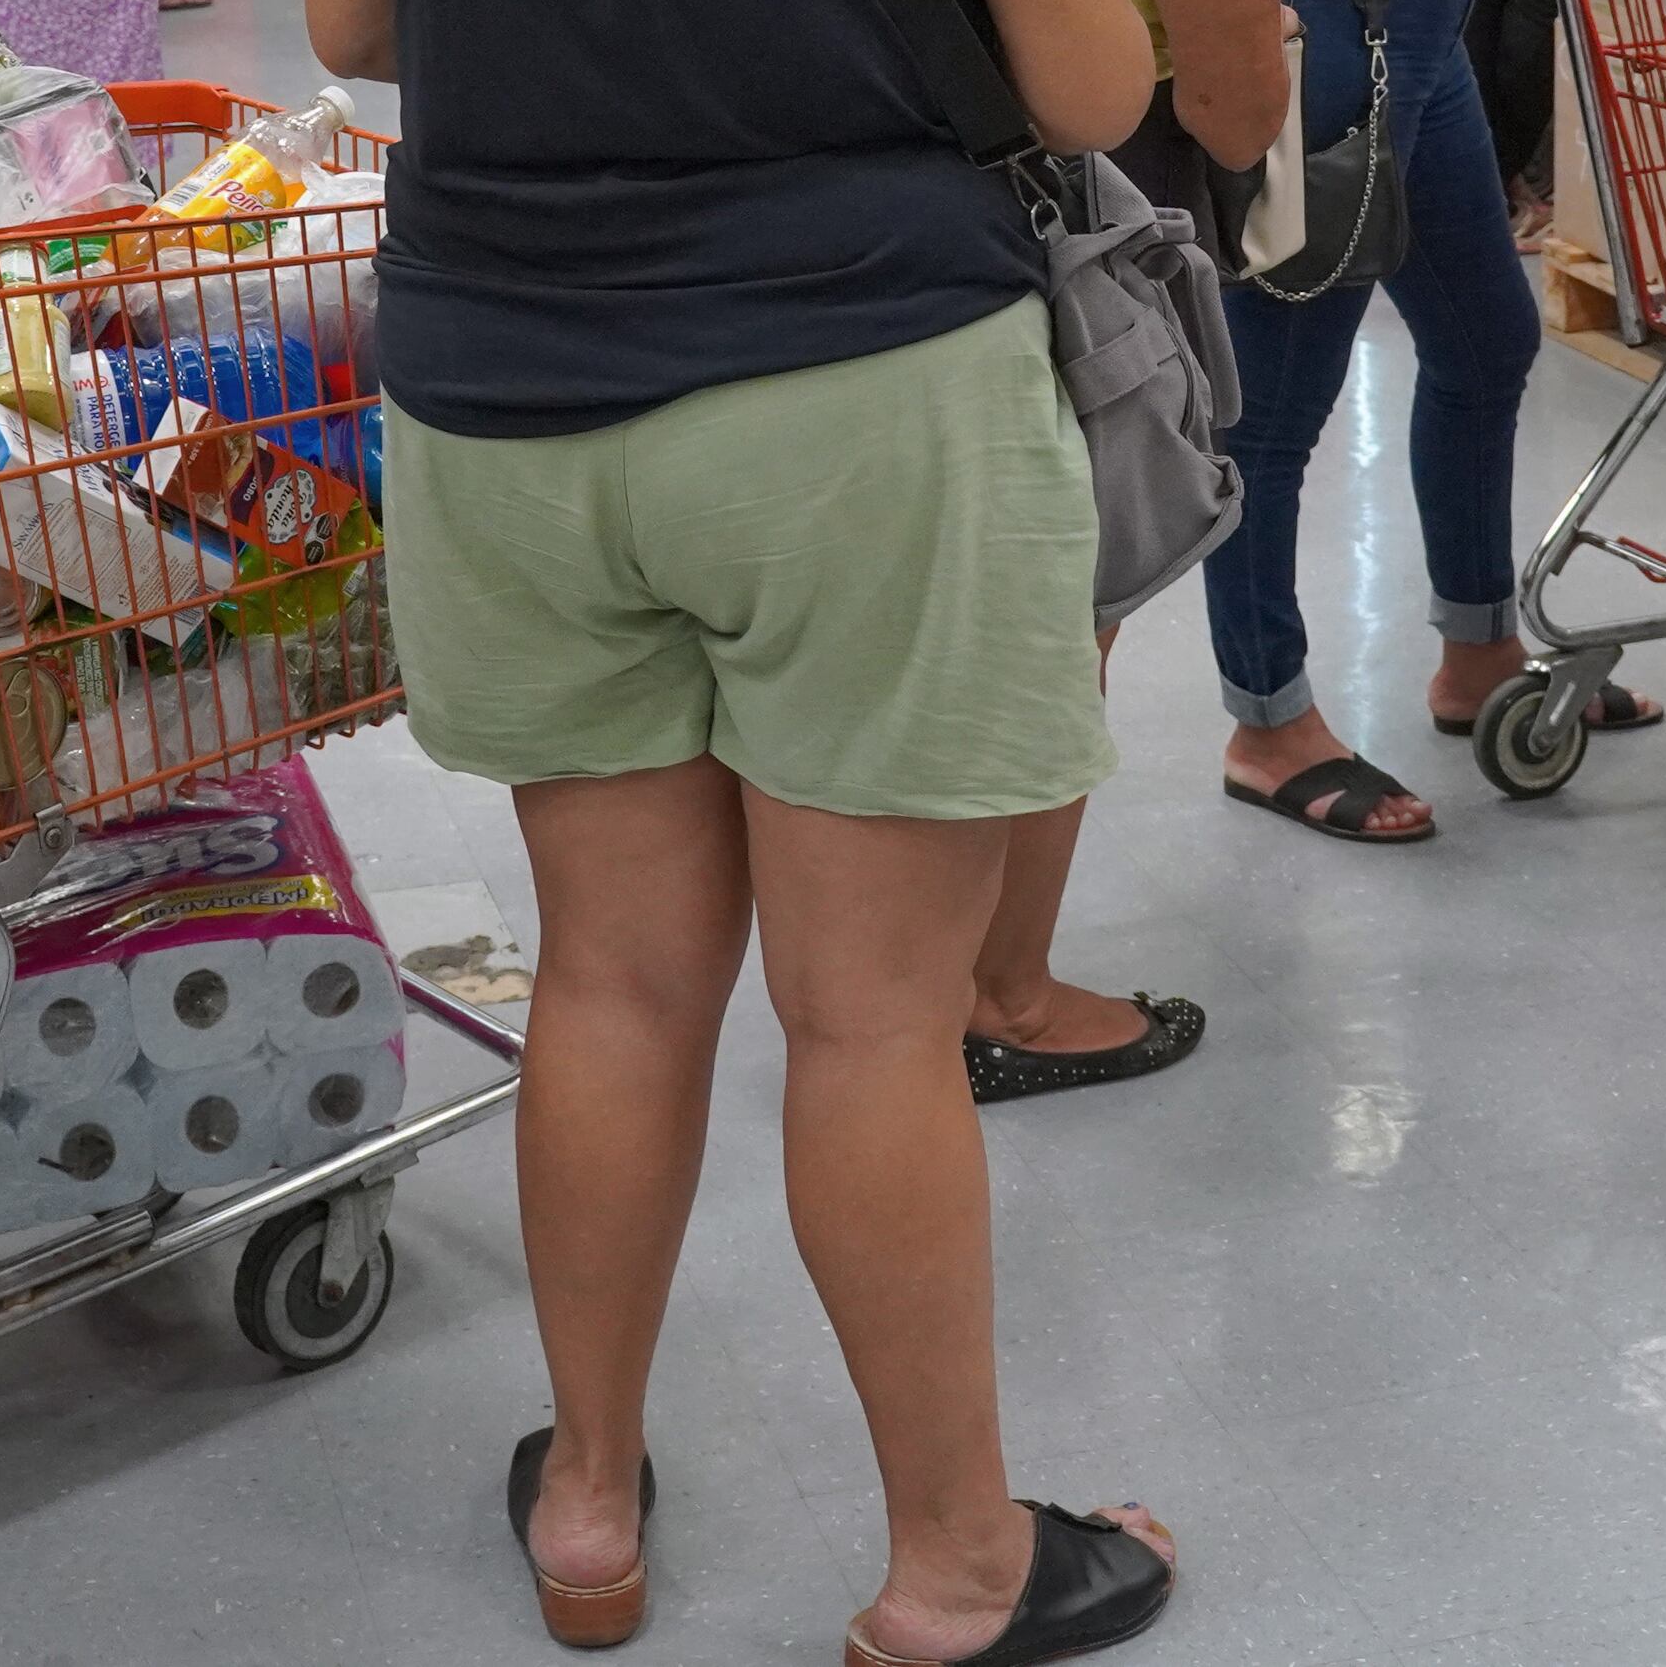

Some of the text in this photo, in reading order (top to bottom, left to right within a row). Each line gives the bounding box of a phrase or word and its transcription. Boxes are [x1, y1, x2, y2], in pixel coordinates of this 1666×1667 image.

[93, 422, 104, 453] RO
[102, 394, 121, 454] DETERGE
[267, 481, 294, 531] honita
[141, 886, 309, 924] ¡MEJORADO!
